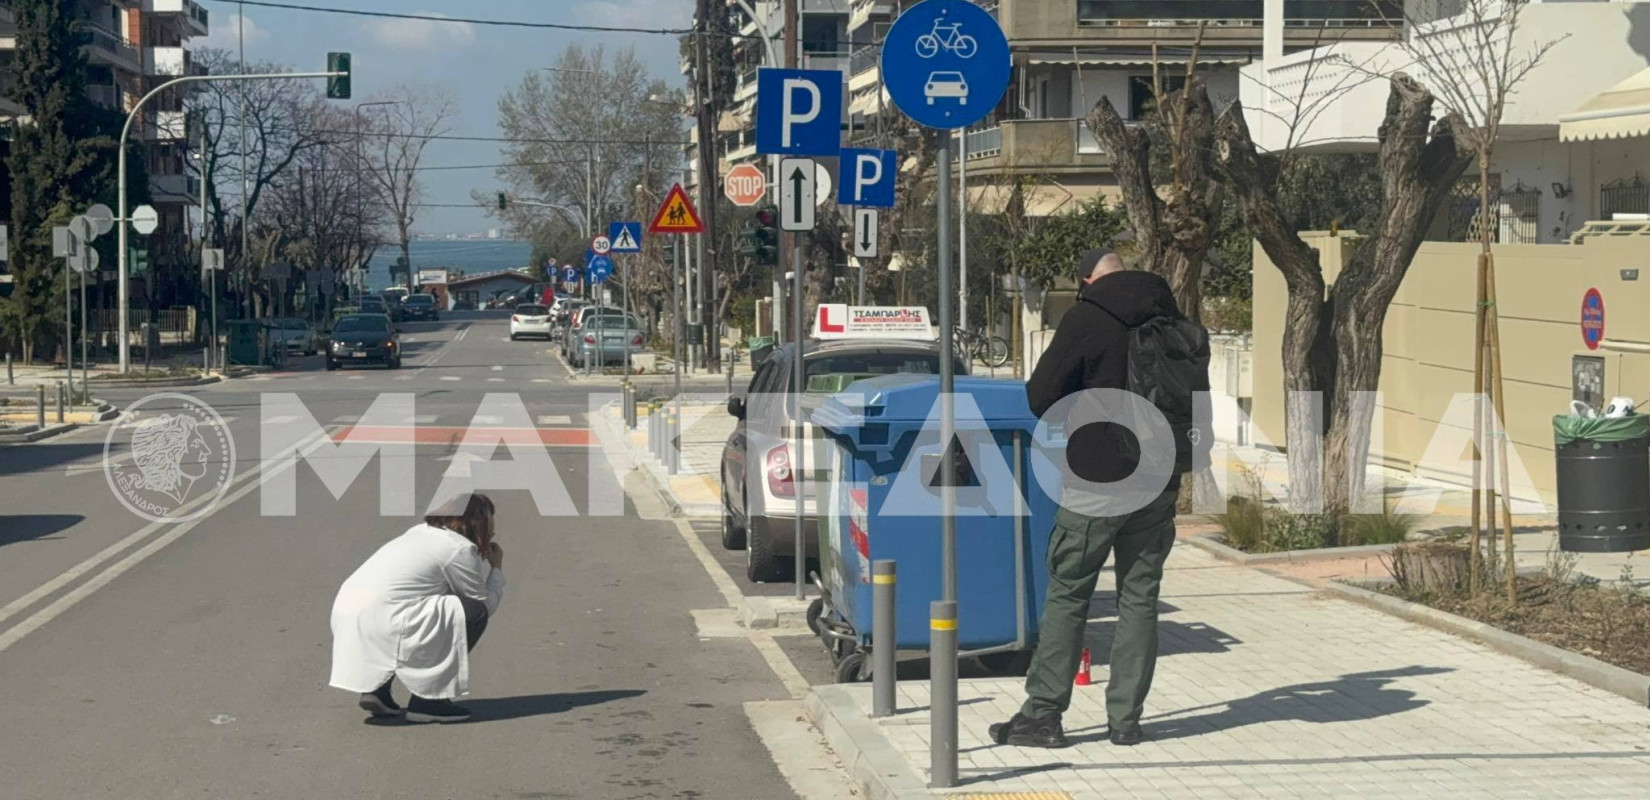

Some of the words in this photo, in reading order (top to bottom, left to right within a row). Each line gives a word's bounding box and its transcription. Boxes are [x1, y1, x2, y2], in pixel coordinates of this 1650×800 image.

[782, 78, 821, 148] P
[728, 176, 762, 196] STOP
[855, 154, 882, 201] P
[596, 241, 608, 249] 30
[567, 269, 575, 281] P
[820, 307, 844, 332] L
